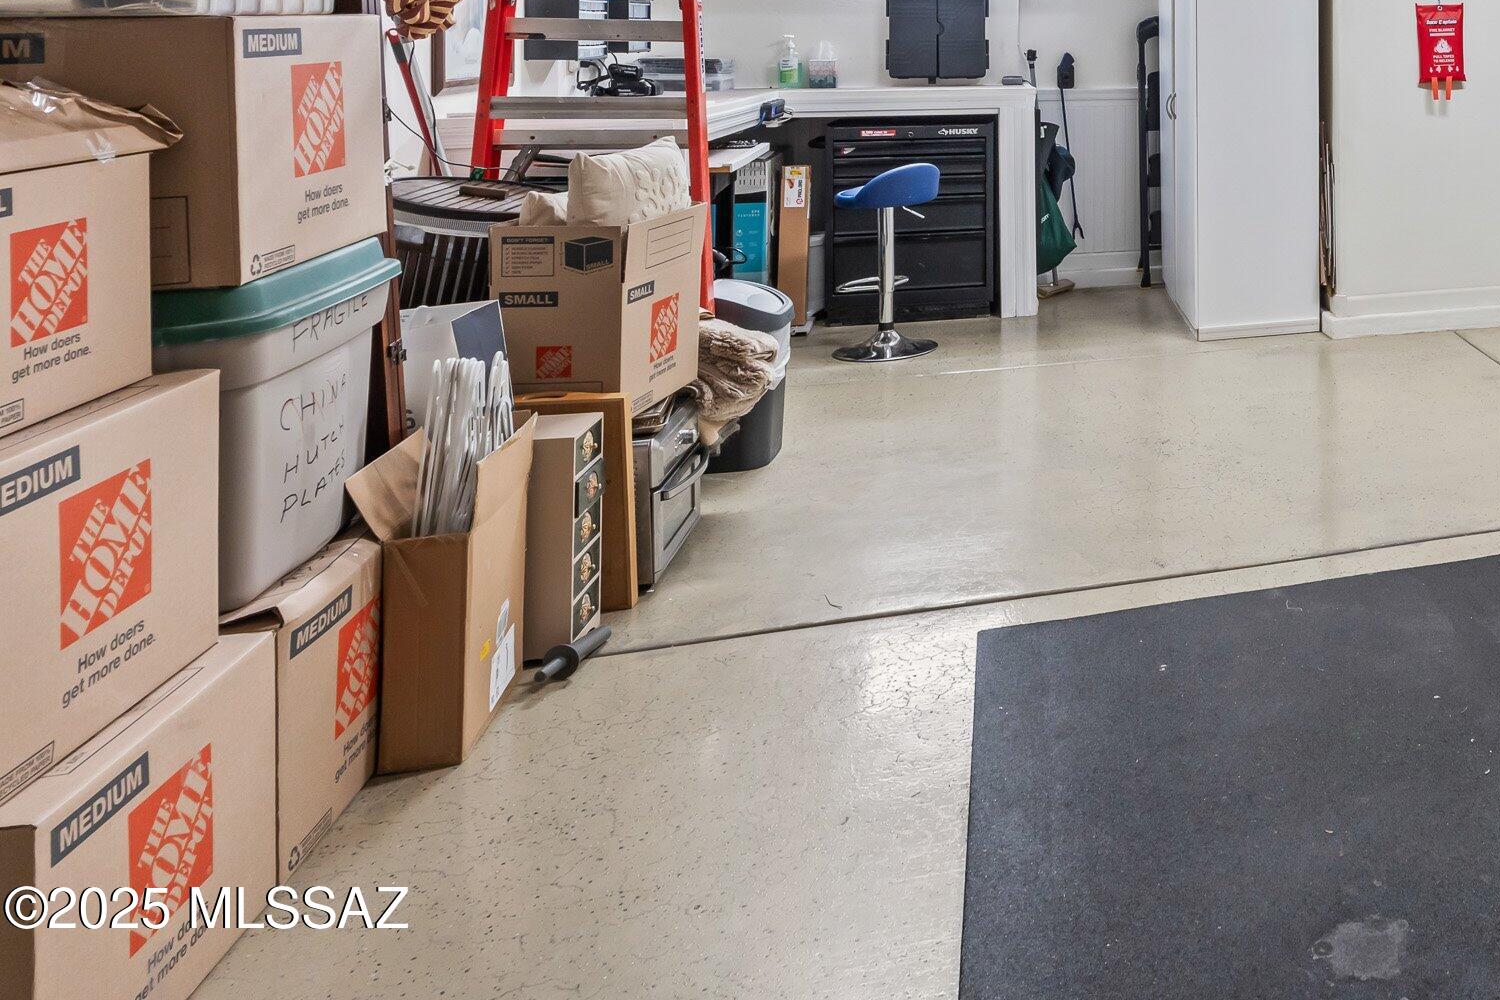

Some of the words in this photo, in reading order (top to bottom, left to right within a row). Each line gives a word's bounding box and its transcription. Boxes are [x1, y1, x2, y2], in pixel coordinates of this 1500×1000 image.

[247, 33, 299, 53] MEDIUM
[294, 61, 343, 176] HOME
[297, 74, 320, 118] THE
[297, 206, 310, 224] get
[311, 204, 330, 218] more
[305, 188, 322, 203] How
[323, 183, 343, 198] doers
[10, 219, 88, 343] HOME
[18, 238, 51, 287] THE
[41, 257, 89, 337] DEPOT
[504, 293, 553, 306] SMALL
[630, 283, 653, 301] SMALL
[23, 343, 49, 361] How
[50, 333, 81, 351] doers
[292, 295, 369, 353] FRAGILE
[11, 364, 31, 385] get
[33, 355, 61, 374] more
[63, 346, 92, 364] done.
[0, 454, 73, 508] EDIUM
[280, 449, 346, 523] PLATES
[60, 465, 151, 638] HOME
[68, 497, 111, 566] THE
[98, 510, 152, 620] DEPOT
[77, 645, 107, 675] How
[110, 619, 145, 654] doers
[296, 593, 350, 650] MEDIUM
[62, 679, 85, 709] get
[87, 659, 121, 688] more
[123, 633, 157, 663] done.
[335, 760, 347, 784] get
[343, 732, 359, 757] How
[59, 764, 143, 853] MEDIUM
[137, 798, 175, 868] THE
[161, 795, 214, 920] DEPOT
[148, 937, 175, 974] How
[158, 943, 188, 983] more
